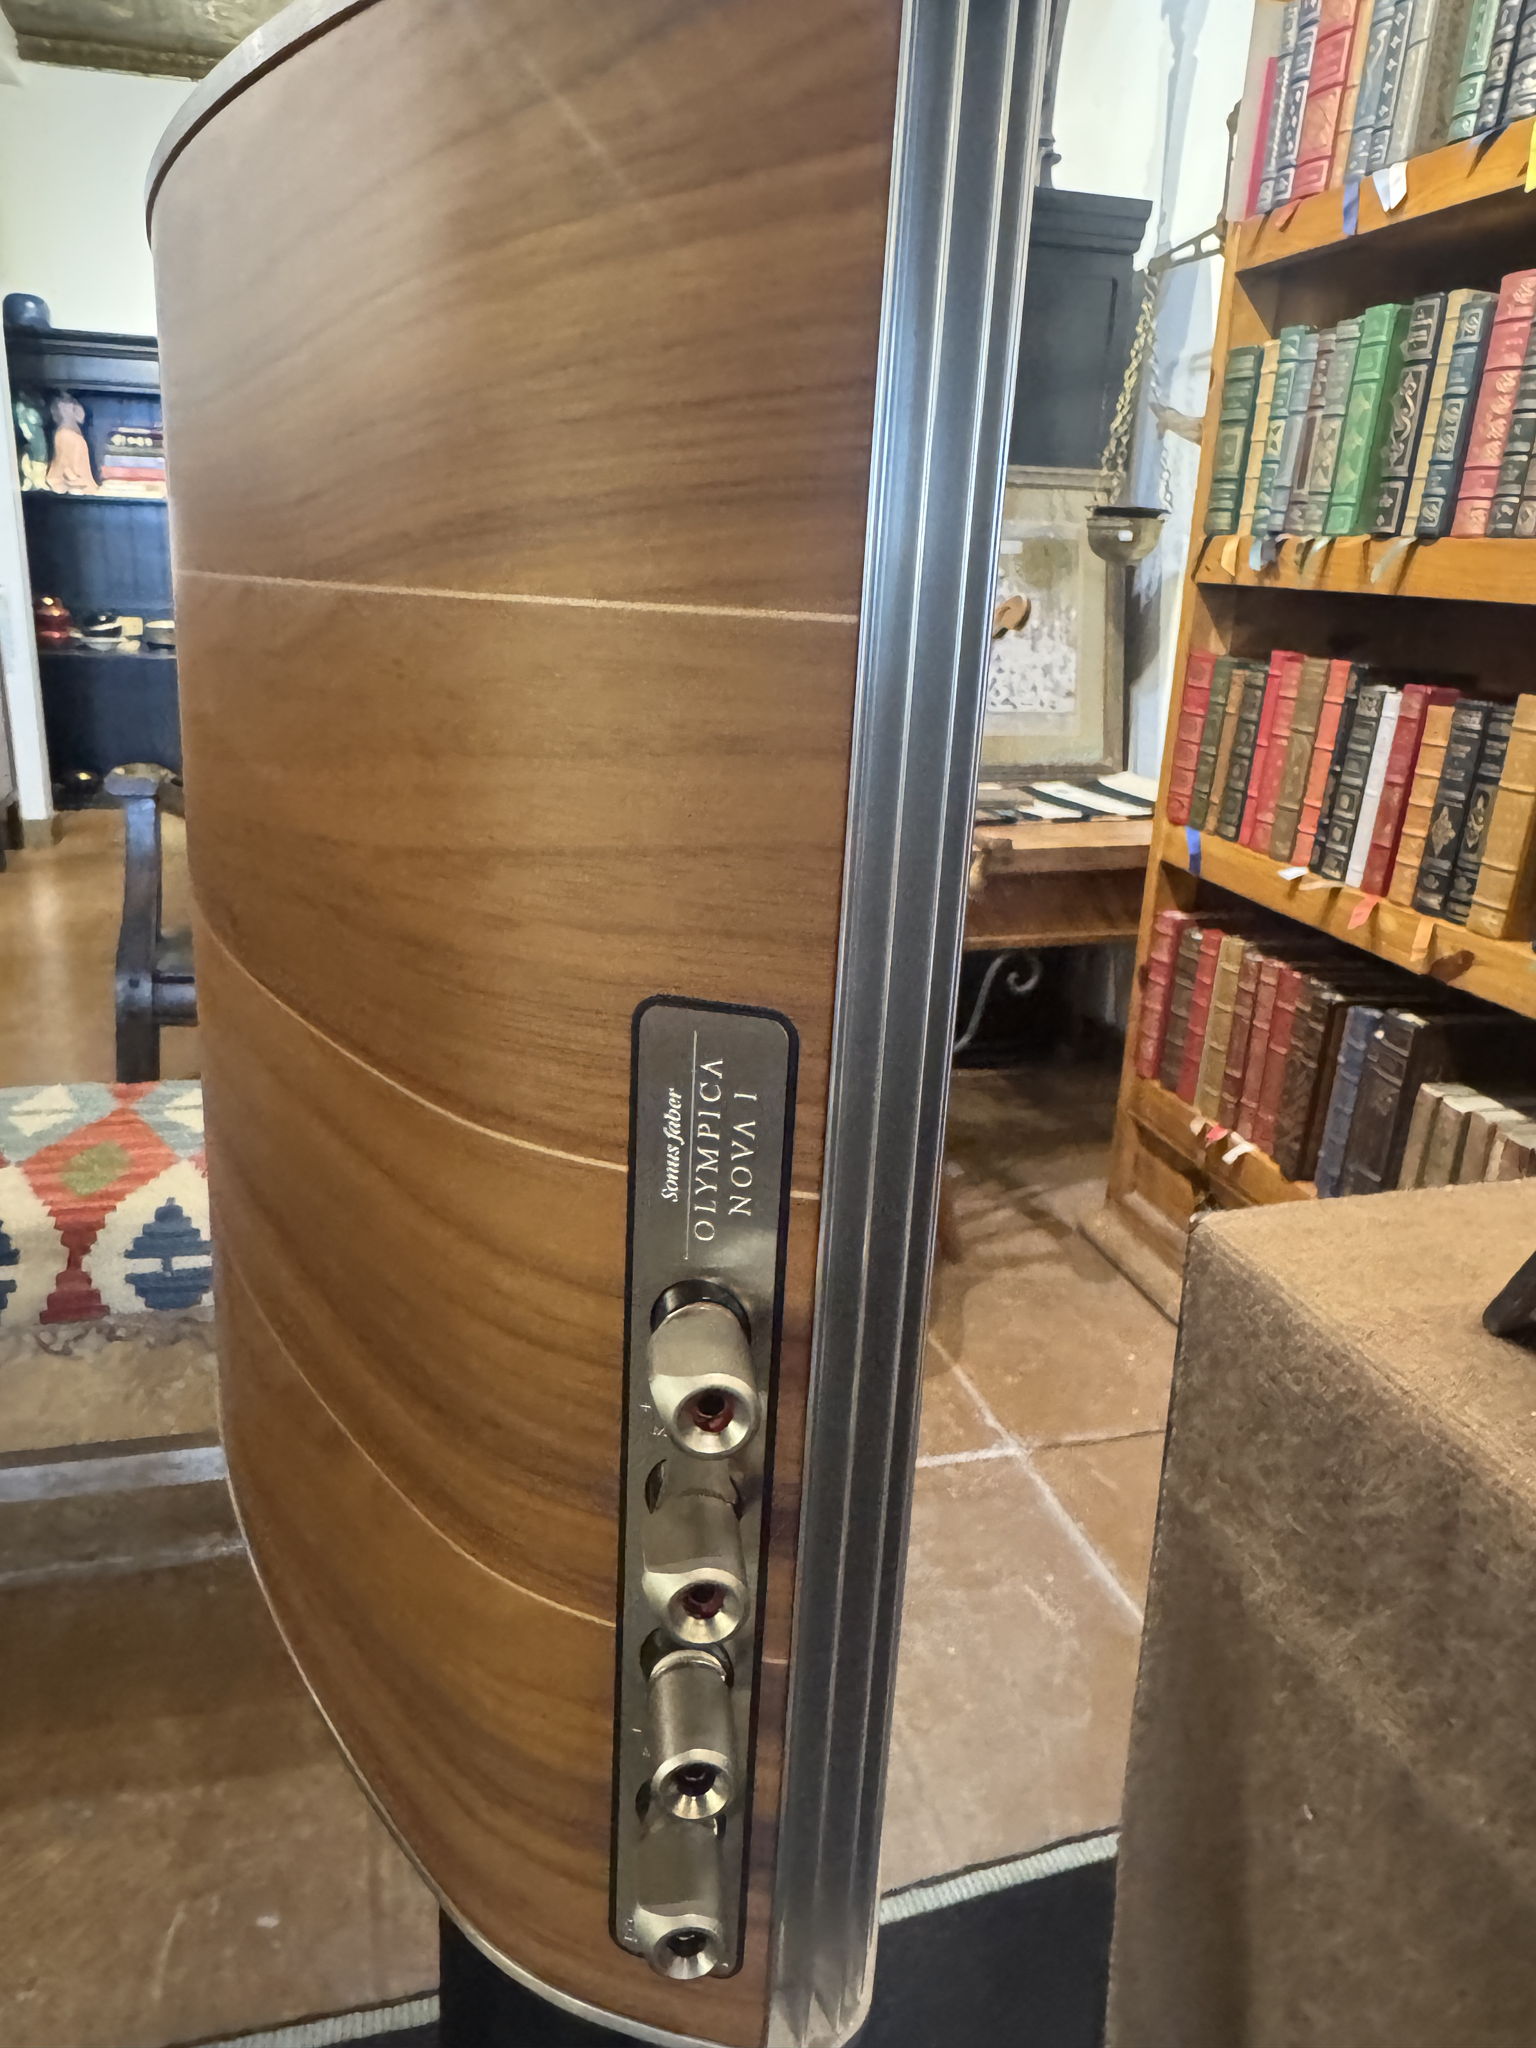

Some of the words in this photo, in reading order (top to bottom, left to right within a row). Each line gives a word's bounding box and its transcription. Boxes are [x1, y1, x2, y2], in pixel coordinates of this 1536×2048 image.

[662, 1087, 686, 1146] faber
[733, 1092, 758, 1102] I
[660, 1143, 682, 1203] Sonus
[693, 1057, 724, 1242] OLYMPICA
[727, 1119, 757, 1217] NOVA
